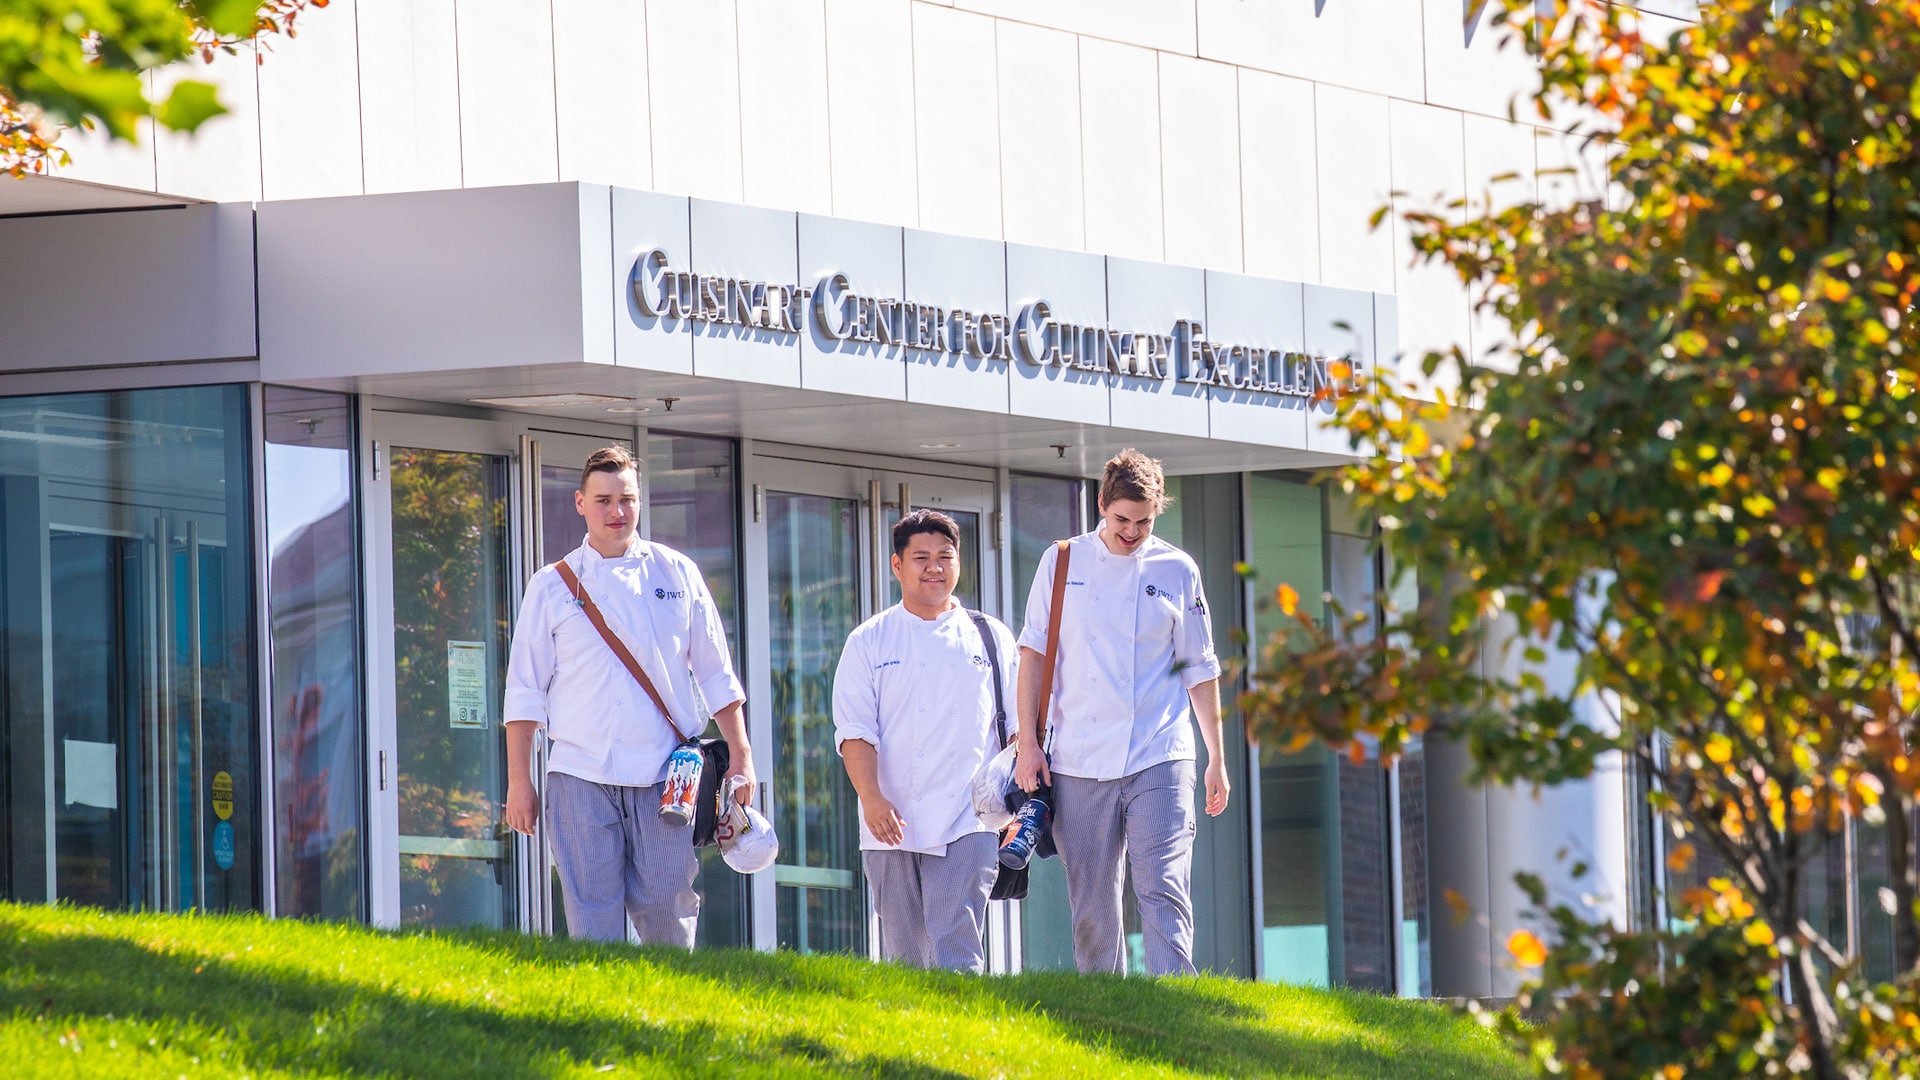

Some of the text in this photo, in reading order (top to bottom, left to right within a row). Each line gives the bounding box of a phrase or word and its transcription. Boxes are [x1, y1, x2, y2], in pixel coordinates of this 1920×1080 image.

[634, 247, 812, 333] CUISINART
[816, 271, 953, 351] CENTER
[951, 309, 1018, 360] FOR
[1018, 298, 1176, 379] CULINARY
[666, 590, 685, 600] JWU
[1157, 590, 1173, 602] JWU
